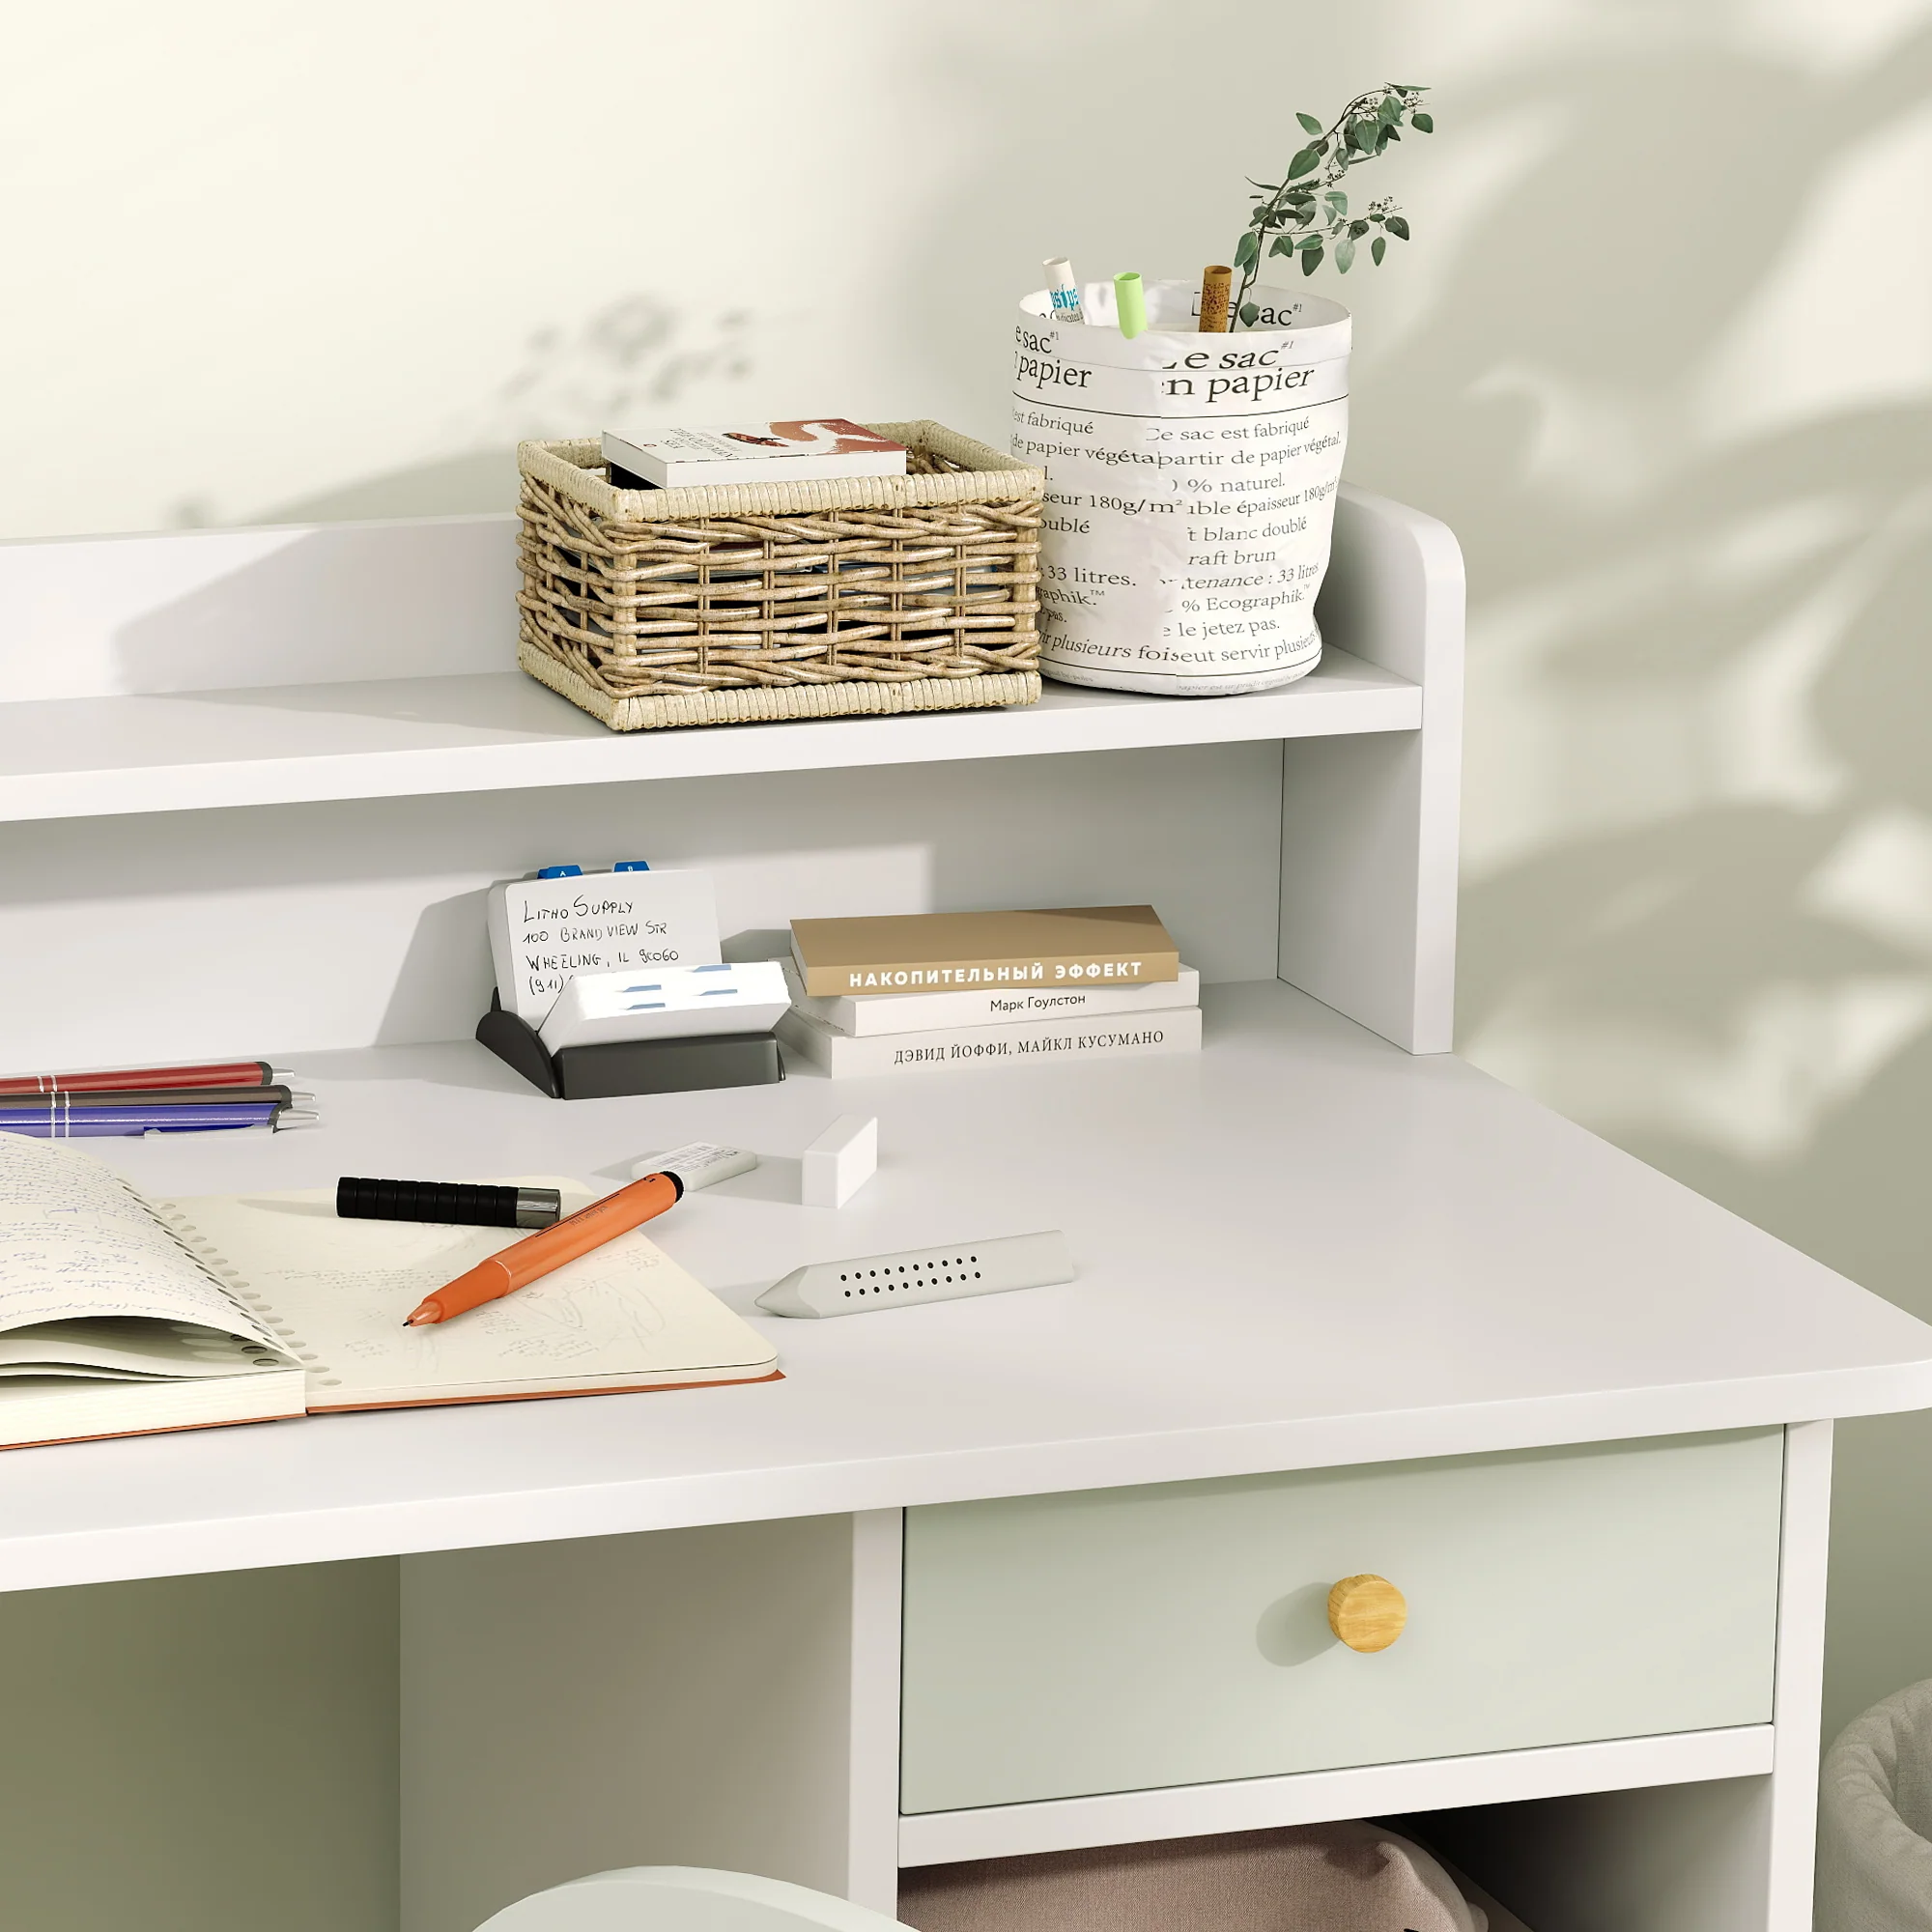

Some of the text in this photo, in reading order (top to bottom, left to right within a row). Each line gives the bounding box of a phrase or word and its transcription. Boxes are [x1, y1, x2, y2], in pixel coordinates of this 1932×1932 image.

[1016, 355, 1093, 390] papier
[1206, 367, 1315, 404] papier
[1027, 412, 1094, 435] fabriqué
[1179, 429, 1215, 441] sac
[1221, 427, 1250, 440] est
[1254, 415, 1310, 438] fabriqué
[1026, 440, 1081, 458] papier
[1231, 450, 1256, 465] de
[1260, 444, 1301, 467] papier
[1303, 431, 1342, 455] végétal.
[1220, 472, 1286, 493] naturel.
[1041, 492, 1083, 506] seur
[1236, 494, 1300, 518] épaisseur
[1040, 516, 1091, 534] oublé
[1204, 526, 1259, 542] blanc
[1262, 516, 1307, 537] doublé
[1187, 550, 1276, 566] raft brun
[1047, 565, 1067, 582] 33
[1073, 567, 1137, 586] litres.
[1181, 574, 1264, 590] tenance
[1276, 569, 1295, 584] 33
[1178, 622, 1197, 638] le
[1202, 621, 1245, 640] jetez
[1248, 618, 1281, 638] pas.
[1051, 635, 1132, 659] plusieurs
[1220, 643, 1271, 662] servir
[522, 930, 549, 945] 100
[848, 961, 1143, 987] НАКОПИТЕЛЬНЫЙ ЭФФЕКТ
[989, 993, 1086, 1012] Марк Гоулстон
[894, 1030, 1165, 1065] ДЭВИД ЙОФФИ, МАЙКЛ КУСУМАНО
